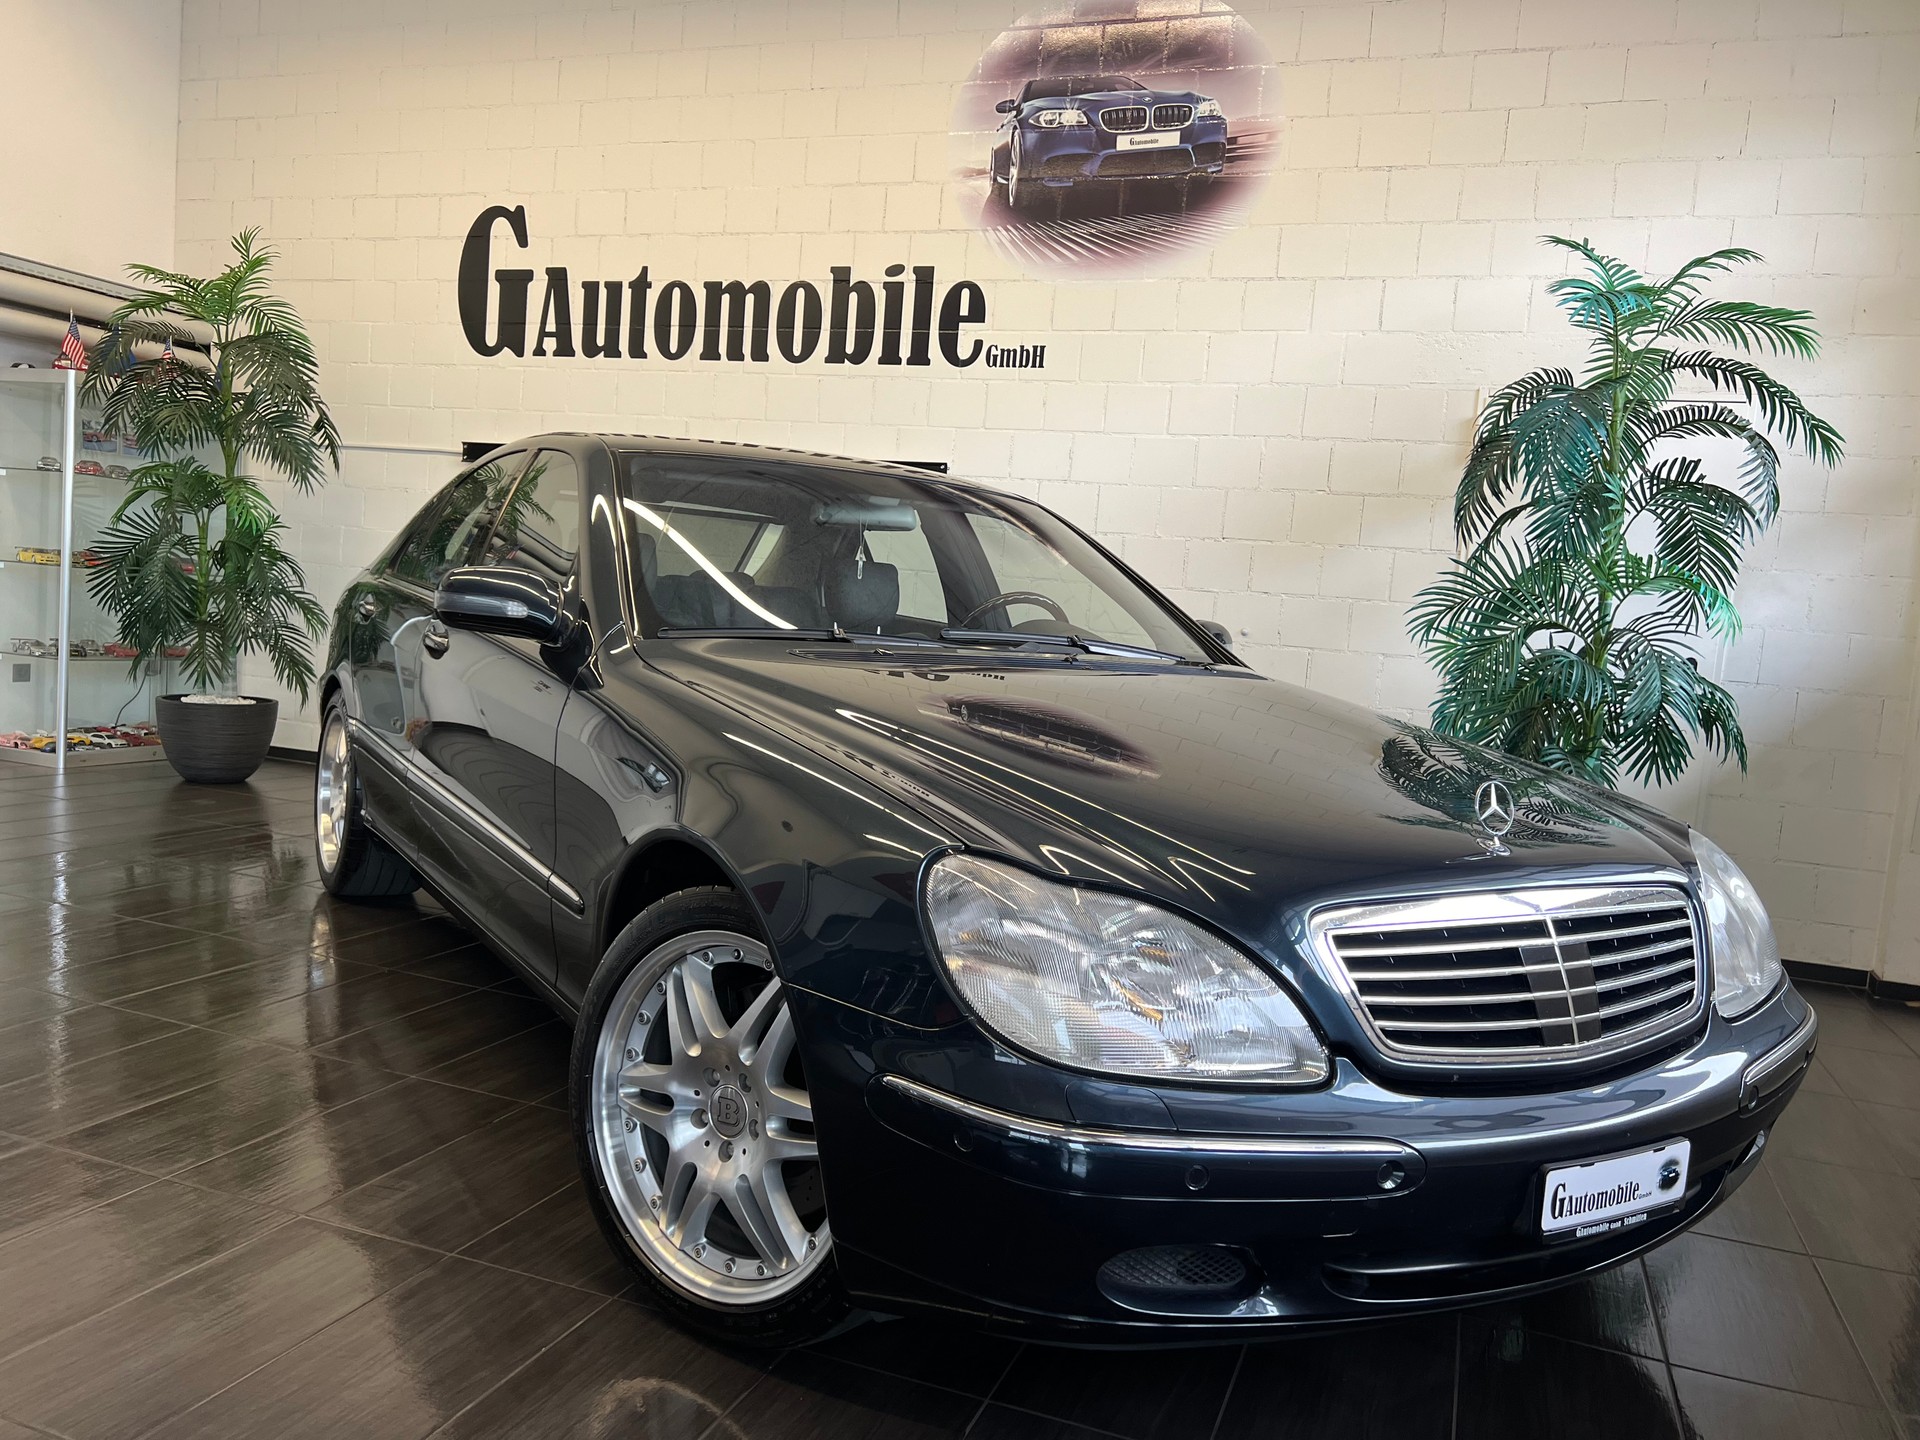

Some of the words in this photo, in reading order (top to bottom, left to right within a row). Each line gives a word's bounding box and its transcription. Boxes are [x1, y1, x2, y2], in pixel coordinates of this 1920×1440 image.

[457, 204, 987, 368] GAutomobile
[985, 344, 1046, 369] GmbH
[717, 1096, 740, 1127] B
[1550, 1182, 1640, 1220] GAutomobile
